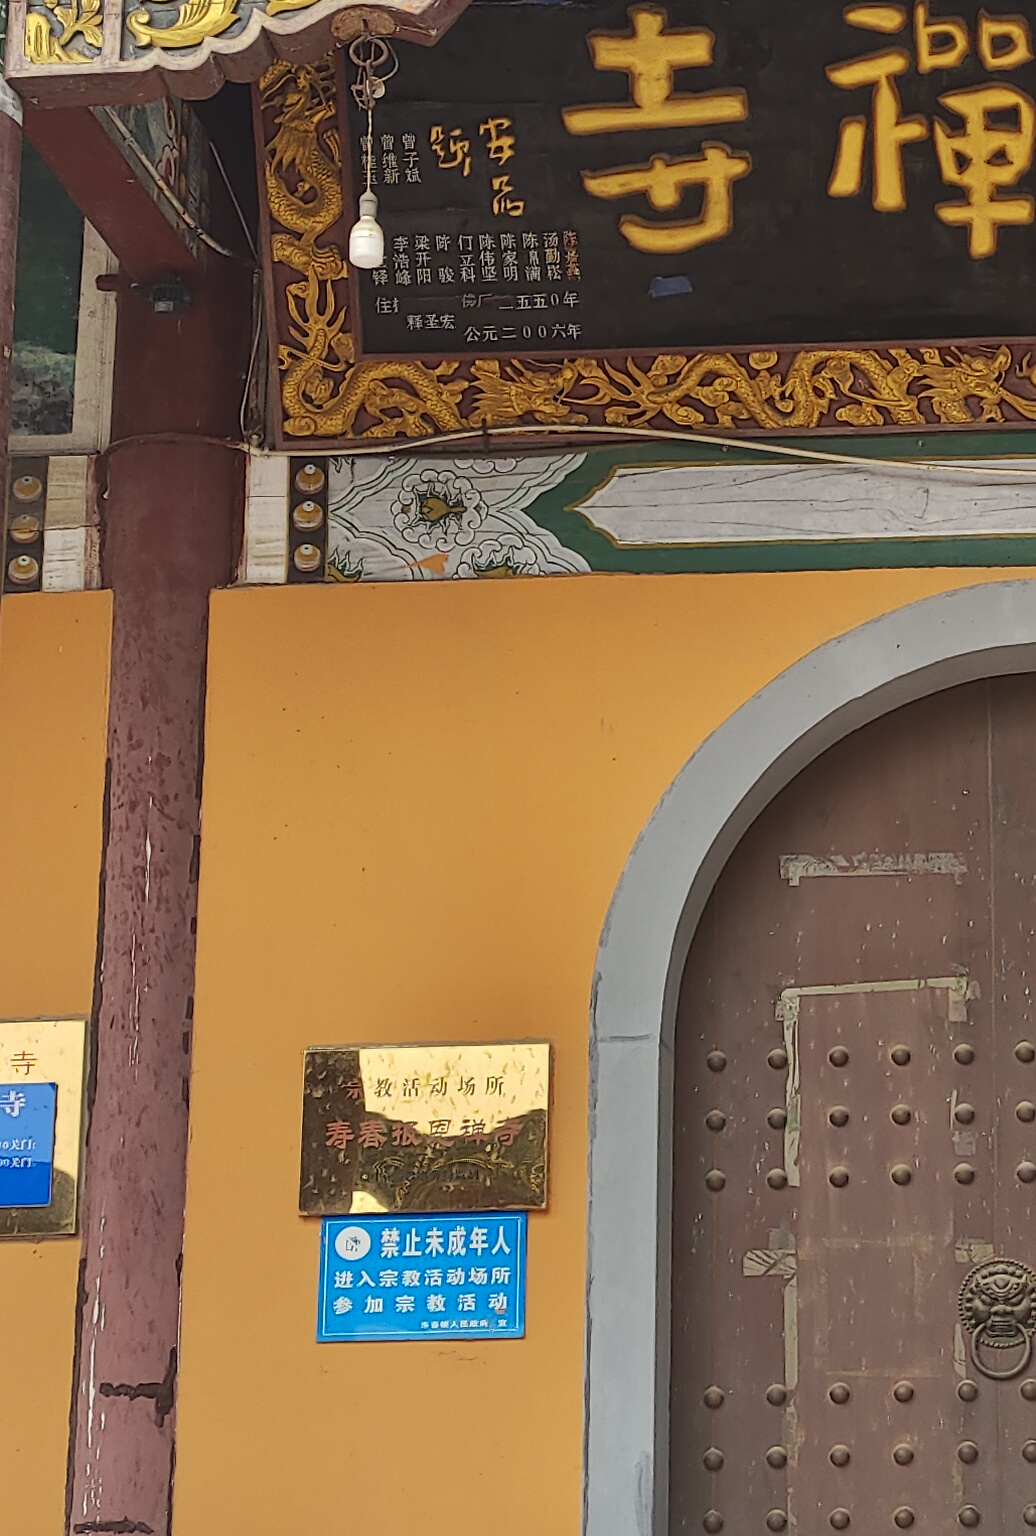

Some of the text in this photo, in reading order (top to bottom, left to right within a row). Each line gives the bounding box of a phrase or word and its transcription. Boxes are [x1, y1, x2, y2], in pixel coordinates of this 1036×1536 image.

[402, 132, 422, 184] 曾子斌
[10, 1050, 37, 1076] 寺
[0, 1090, 26, 1117] 寺
[380, 1225, 511, 1259] 禁止未成年人
[334, 1267, 511, 1289] 进入宗教活动场所
[333, 1293, 508, 1315] 参加宗教活动
